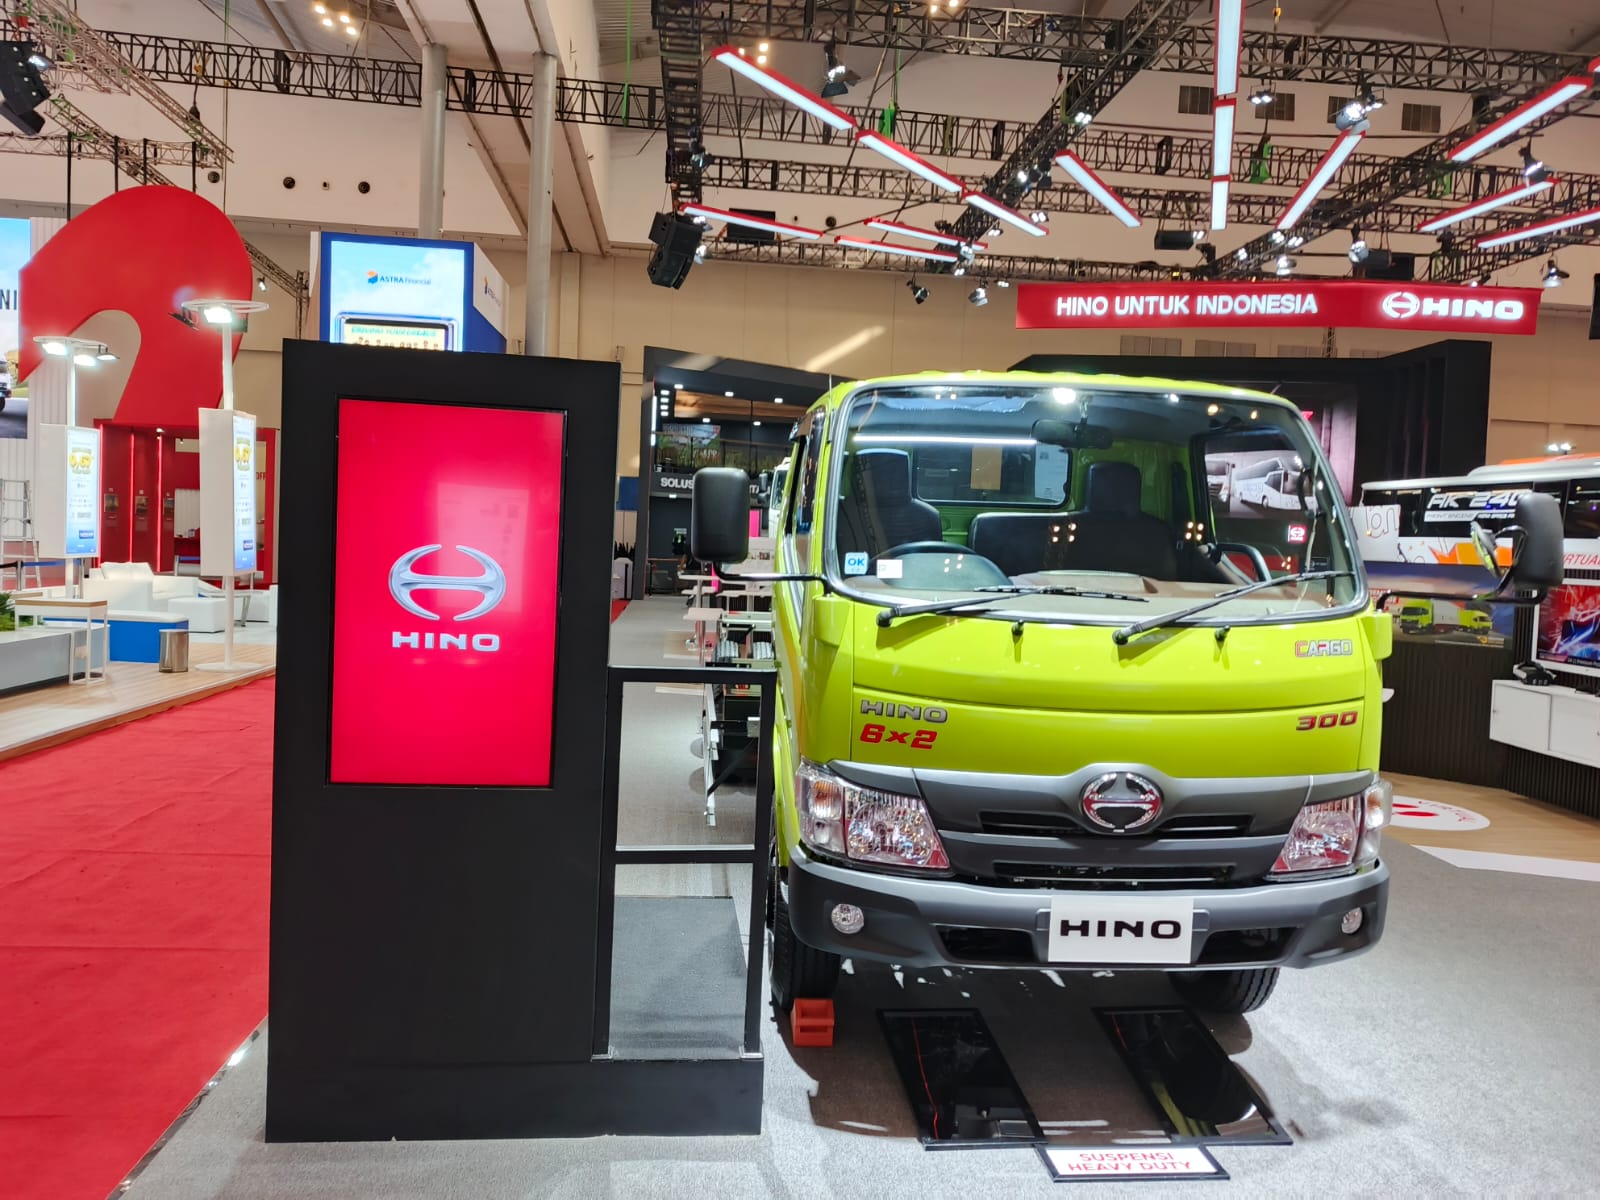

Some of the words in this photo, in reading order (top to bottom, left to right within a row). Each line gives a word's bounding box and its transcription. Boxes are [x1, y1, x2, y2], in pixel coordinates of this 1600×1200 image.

[380, 275, 404, 284] ASTRA
[1056, 296, 1108, 316] HINO
[1115, 295, 1190, 315] UNTUK
[1196, 294, 1319, 315] INDONESIA
[1421, 297, 1524, 320] HINO
[847, 558, 865, 566] OK
[391, 631, 500, 652] HINO
[1295, 639, 1353, 657] CARGO
[860, 699, 948, 723] HINO
[1296, 711, 1359, 731] 300
[860, 723, 938, 750] 6x2
[1060, 919, 1182, 940] HINO
[1068, 1162, 1132, 1171] HEAVY
[1140, 1161, 1191, 1171] DUTY
[1079, 1152, 1174, 1162] SUSPENSI
